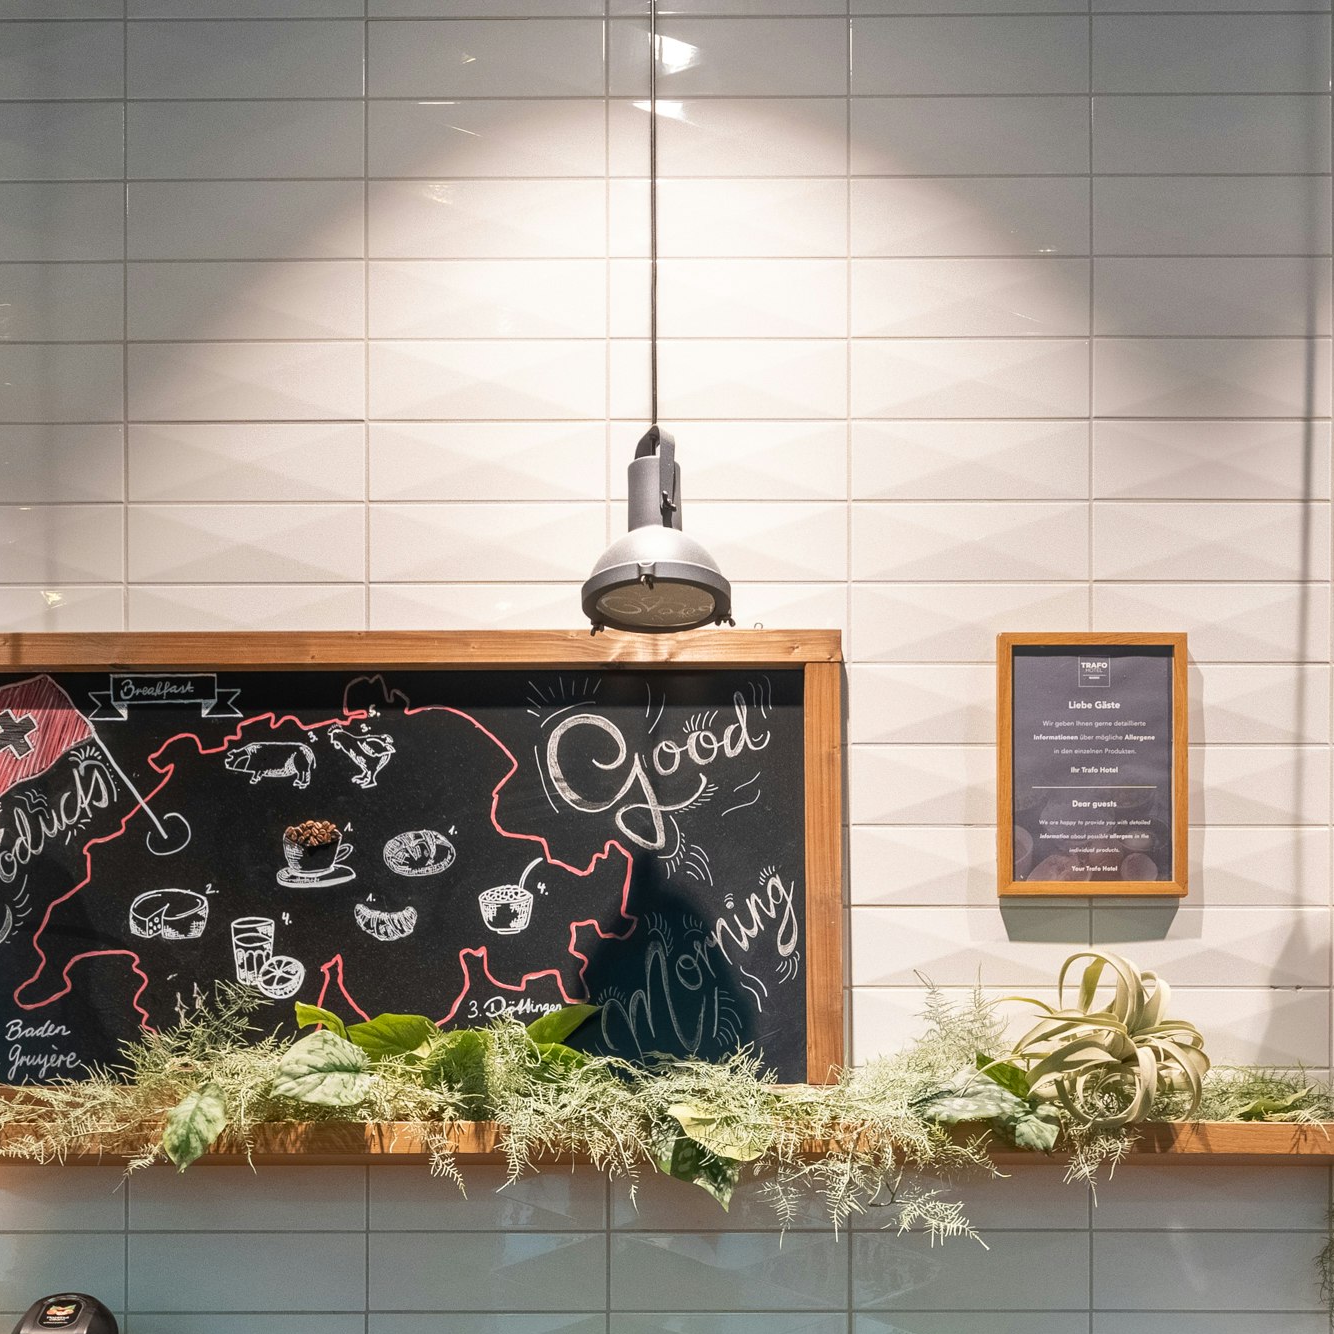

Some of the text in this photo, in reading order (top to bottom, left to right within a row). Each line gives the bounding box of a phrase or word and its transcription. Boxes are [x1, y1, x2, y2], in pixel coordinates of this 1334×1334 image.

[120, 679, 194, 699] Breakfast
[1068, 701, 1120, 709] Liebe Gäste
[1055, 720, 1074, 728] geben
[1095, 734, 1123, 742] mögliche
[1124, 734, 1155, 742] Allergene
[547, 691, 771, 850] Good
[1092, 800, 1117, 809] guests
[205, 884, 219, 895] 2.
[468, 1000, 482, 1018] 3.
[5, 1019, 71, 1041] Baden
